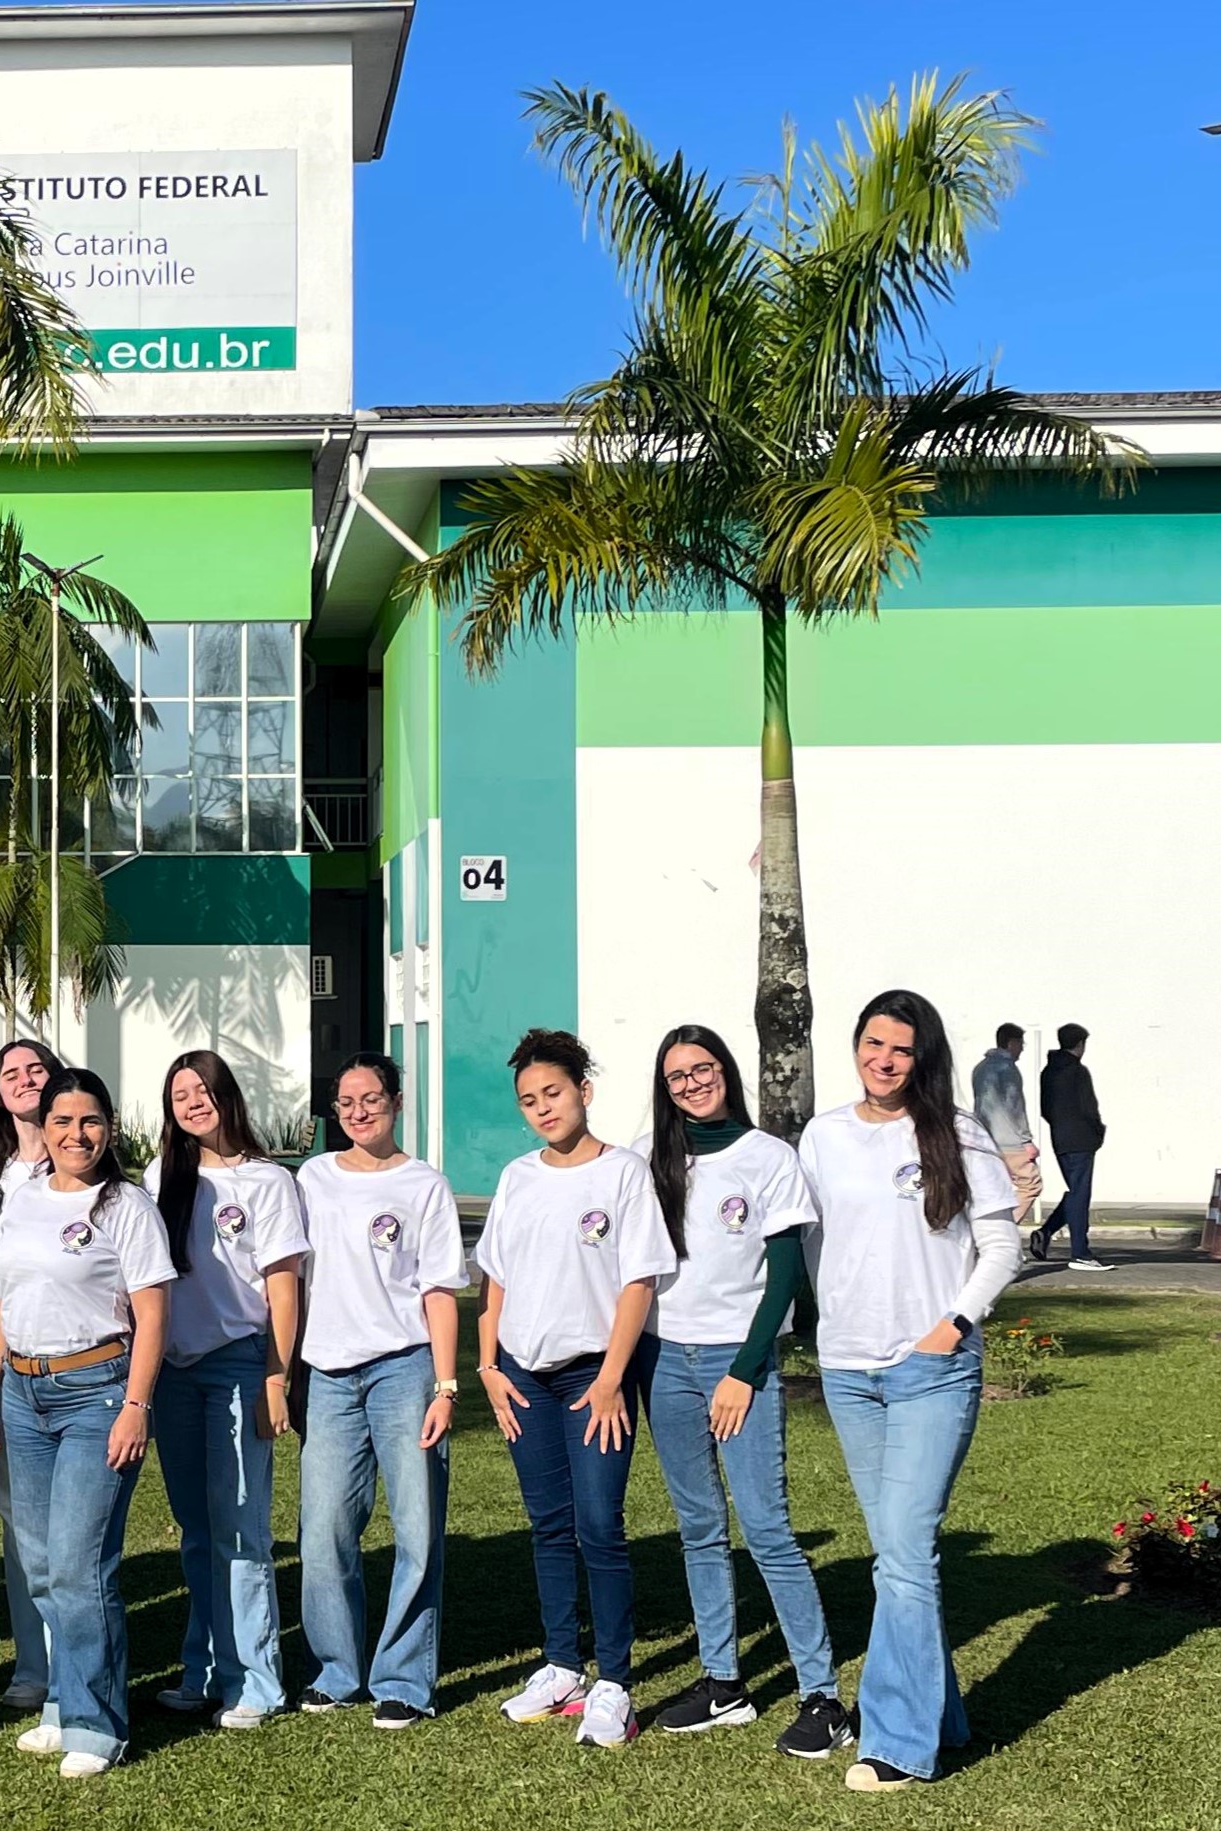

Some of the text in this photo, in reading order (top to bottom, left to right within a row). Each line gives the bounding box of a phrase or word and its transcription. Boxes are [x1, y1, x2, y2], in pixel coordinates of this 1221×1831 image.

[139, 175, 269, 199] FEDERAL
[54, 231, 168, 256] Catarina
[85, 260, 196, 288] Joinville
[463, 859, 505, 890] 04
